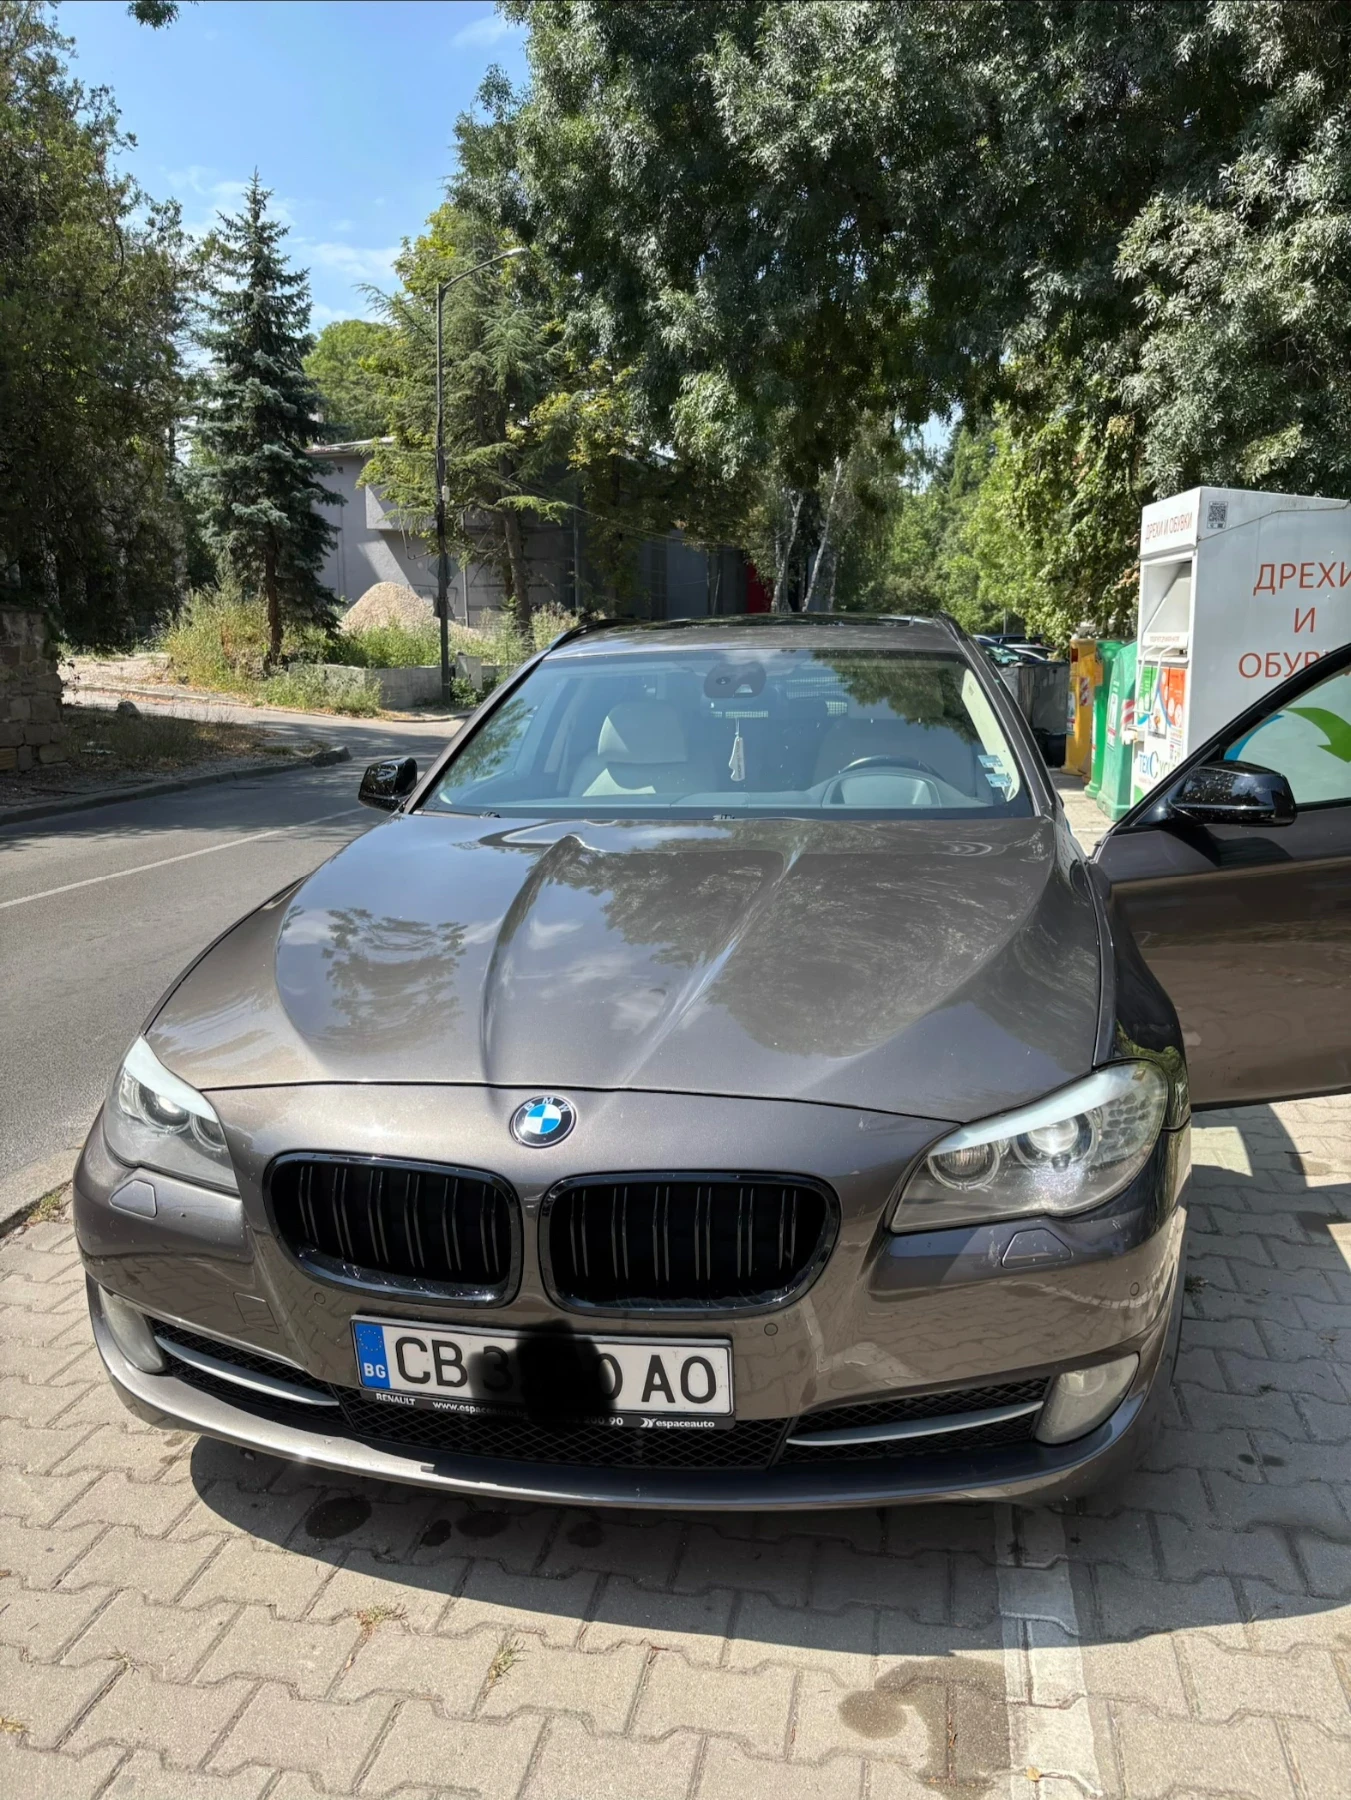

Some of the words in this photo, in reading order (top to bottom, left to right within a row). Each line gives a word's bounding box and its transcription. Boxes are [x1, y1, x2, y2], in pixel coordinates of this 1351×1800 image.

[1294, 607, 1315, 633] И
[1238, 651, 1350, 678] ОБУ
[524, 1096, 570, 1112] BMW
[363, 1362, 386, 1379] BG
[395, 1336, 468, 1388] CB
[641, 1354, 717, 1404] AO
[375, 1393, 416, 1406] RENAULT
[608, 1416, 624, 1426] 90
[655, 1420, 715, 1429] espaceauto
